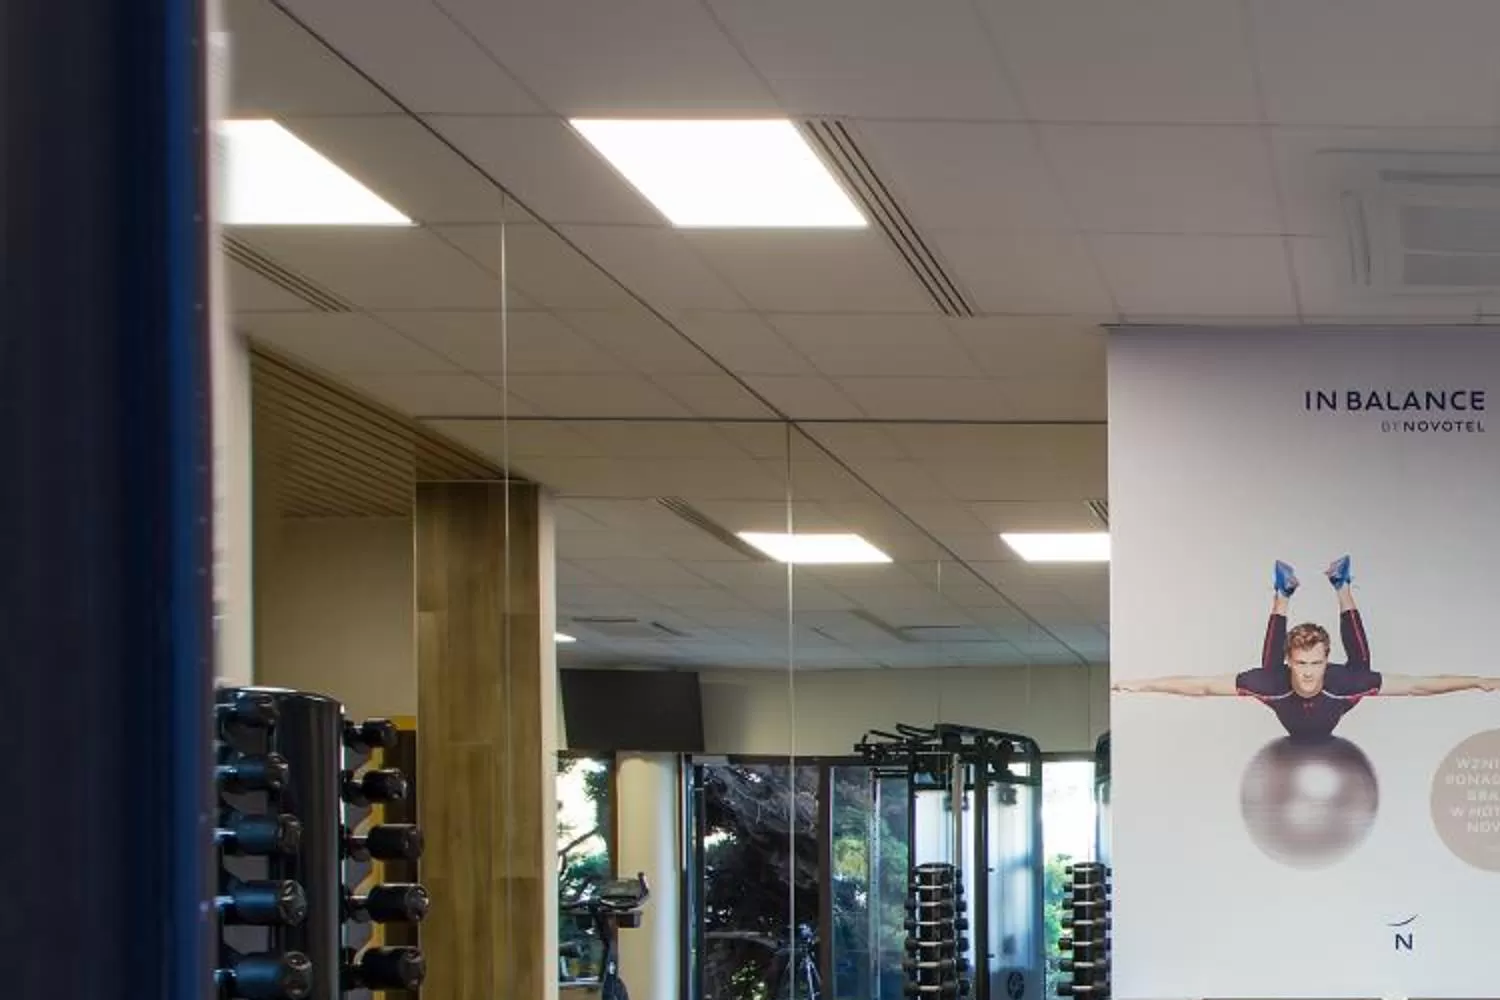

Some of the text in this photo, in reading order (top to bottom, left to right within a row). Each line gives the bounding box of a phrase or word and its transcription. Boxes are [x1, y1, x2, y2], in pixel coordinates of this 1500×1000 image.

[1304, 390, 1486, 411] IN BALANCE
[1403, 420, 1487, 433] NOVOTEL
[1395, 933, 1413, 950] N
